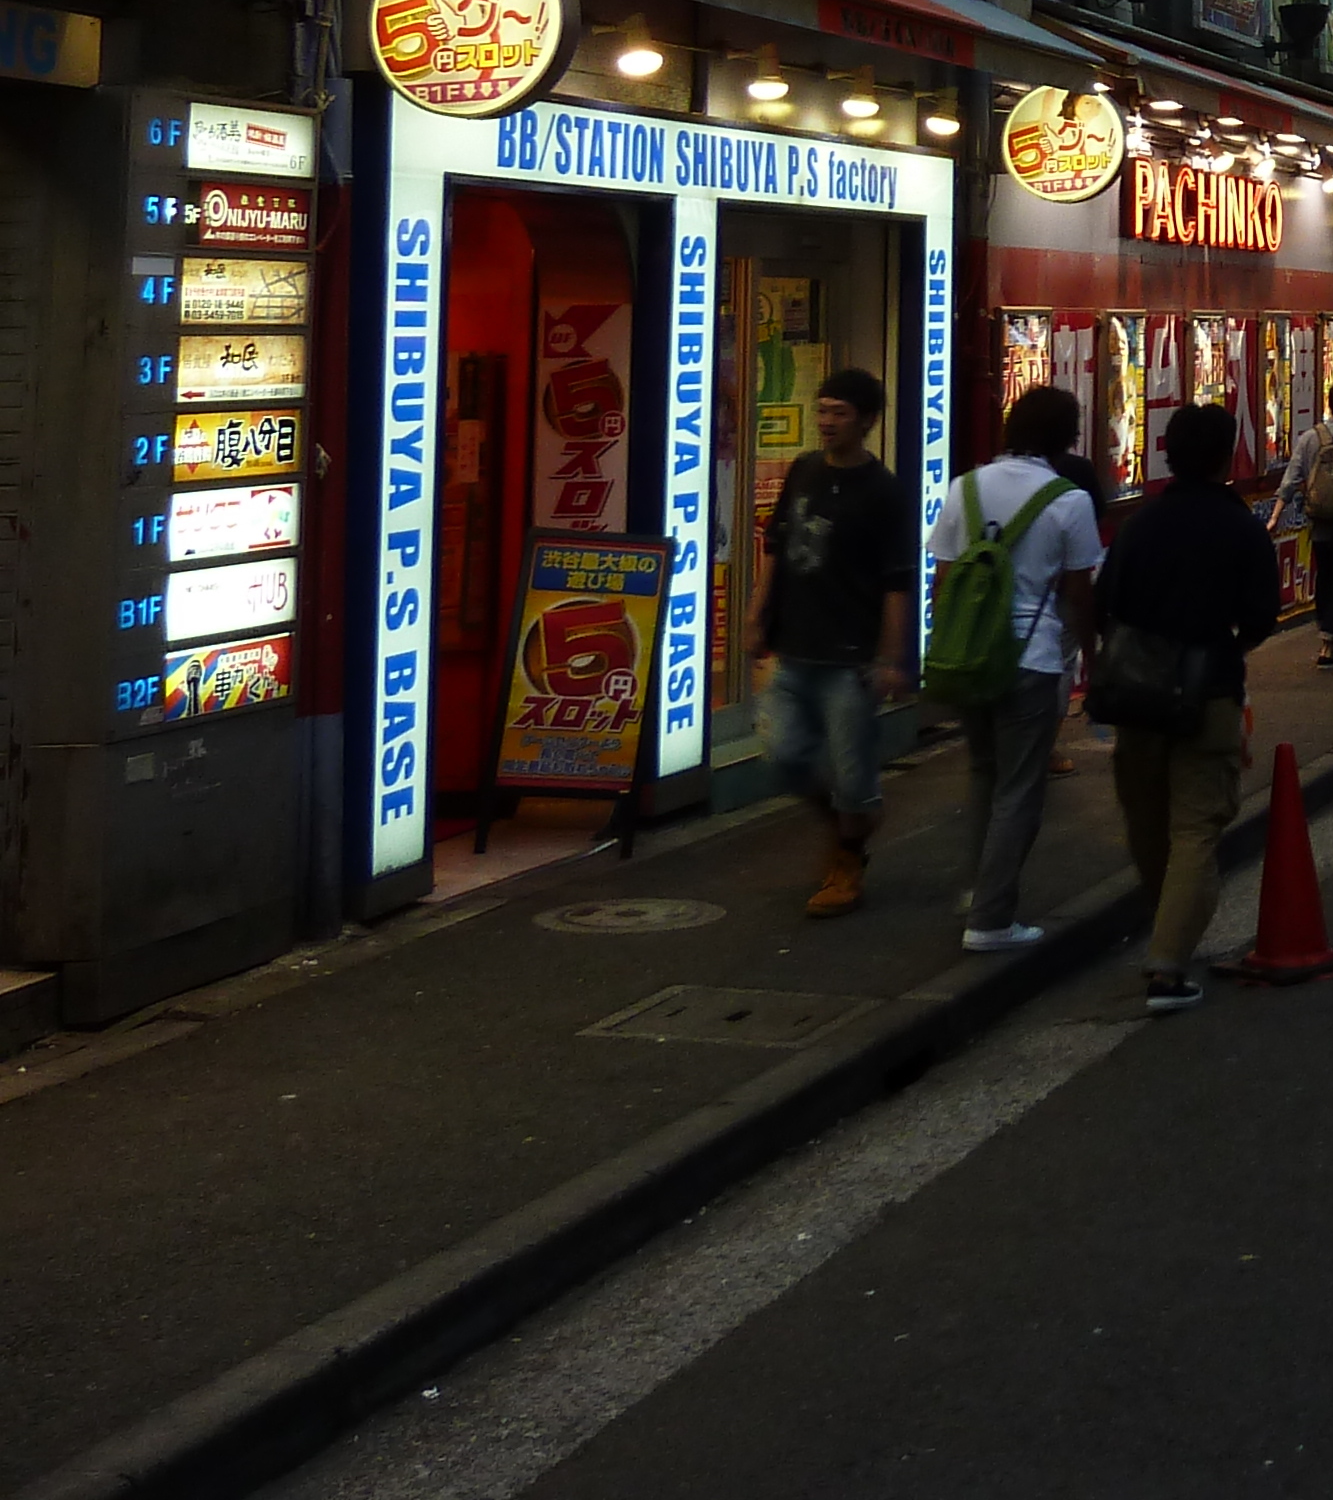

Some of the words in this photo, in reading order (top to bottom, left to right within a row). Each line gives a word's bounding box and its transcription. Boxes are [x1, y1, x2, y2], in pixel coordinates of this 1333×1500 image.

[149, 118, 182, 147] 6F
[497, 108, 664, 184] BB/STATION
[676, 129, 778, 195] SHIBUYA
[788, 144, 819, 199] P.S
[827, 150, 898, 210] factory
[145, 196, 178, 225] 5F
[184, 204, 201, 224] 5F
[1133, 156, 1283, 253] PACHINKO
[141, 276, 176, 304] 4F
[137, 355, 172, 385] 3F
[388, 216, 431, 511] SHIBUYA
[673, 235, 707, 478] SHIBUYA
[925, 249, 946, 447] SHIBUYA
[133, 435, 168, 467] 2F
[213, 415, 296, 470] 腹八分目
[132, 515, 166, 546] 1F
[667, 491, 700, 582] P.S
[384, 528, 421, 632] P.S
[118, 595, 162, 630] B1F
[666, 591, 699, 736] BASE
[117, 676, 160, 711] B2F
[510, 696, 642, 733] スロット
[380, 649, 417, 827] BASE
